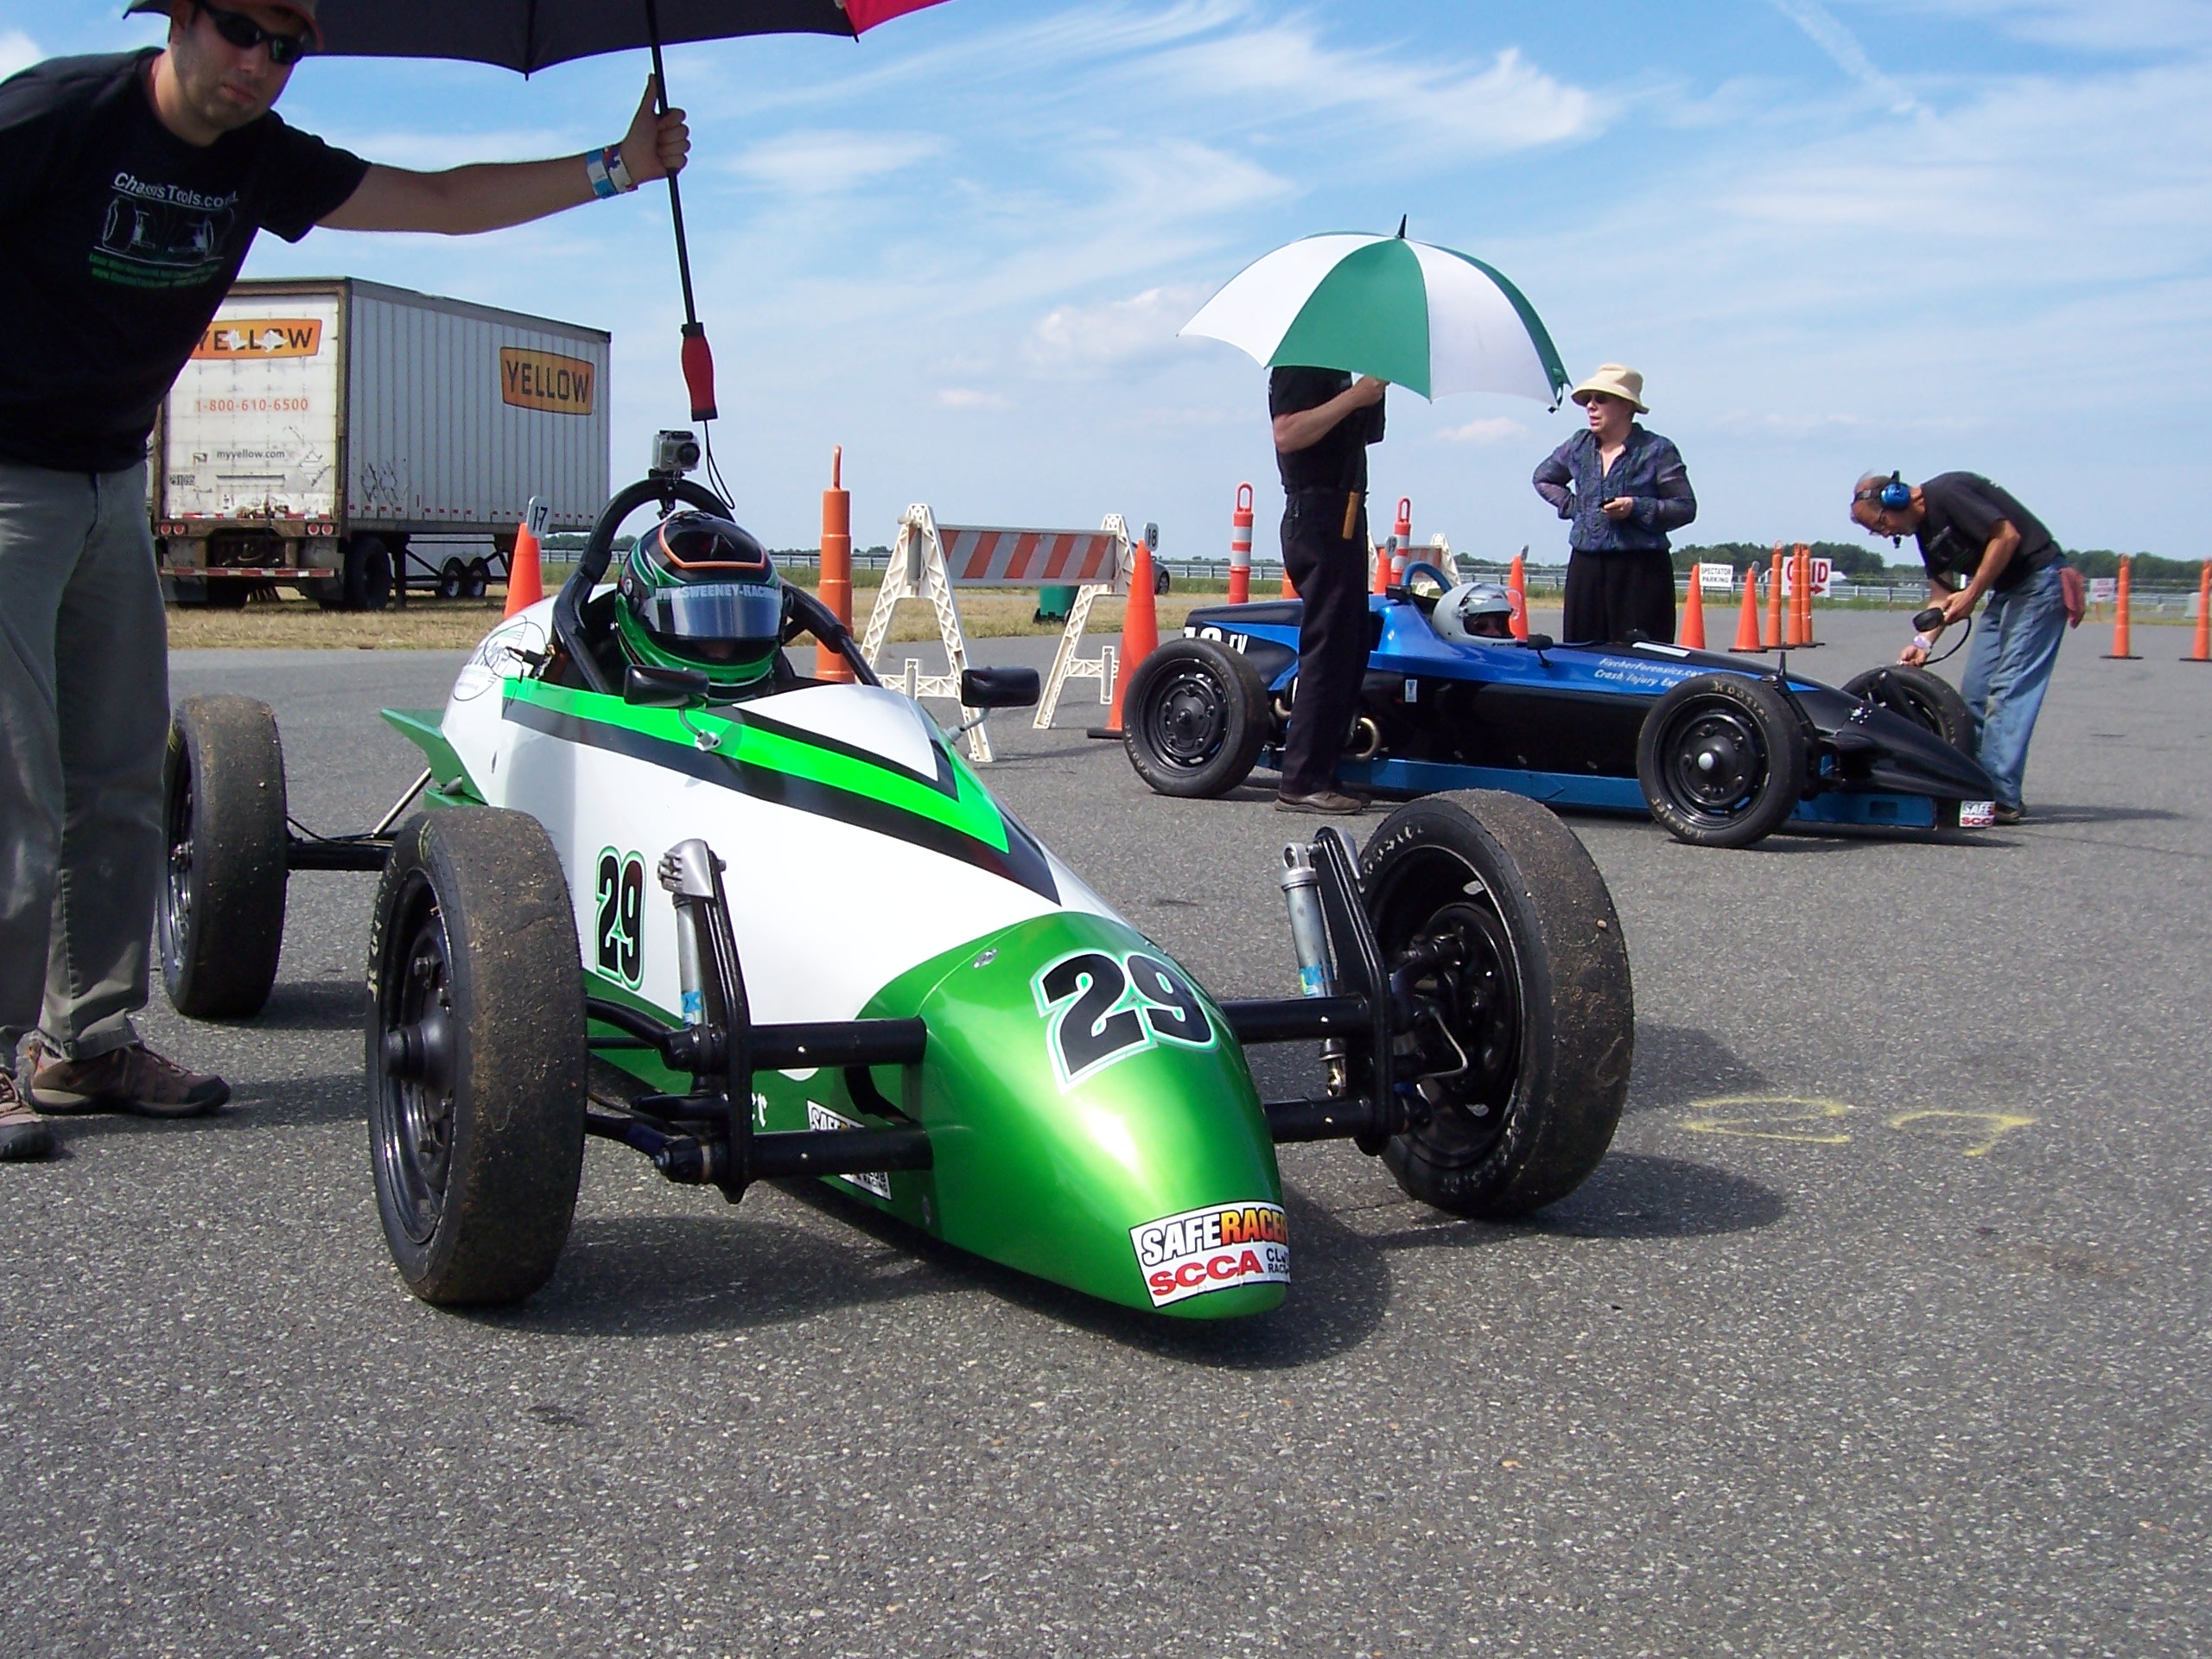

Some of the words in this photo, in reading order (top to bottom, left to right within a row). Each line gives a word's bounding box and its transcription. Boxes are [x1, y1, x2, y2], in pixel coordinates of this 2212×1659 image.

[506, 360, 589, 404] YELLOW
[195, 398, 308, 411] 1-800-610-6500
[216, 448, 285, 461] myyellow.com
[532, 505, 549, 532] 17
[1147, 528, 1158, 547] 18
[1700, 567, 1732, 575] SPECTATOR
[1593, 668, 1624, 681] Crash
[1625, 672, 1659, 687] Injury
[1961, 803, 1995, 815] SAFE
[597, 851, 645, 987] 29
[1035, 950, 1217, 1083] 29
[1149, 1249, 1264, 1296] SCCA
